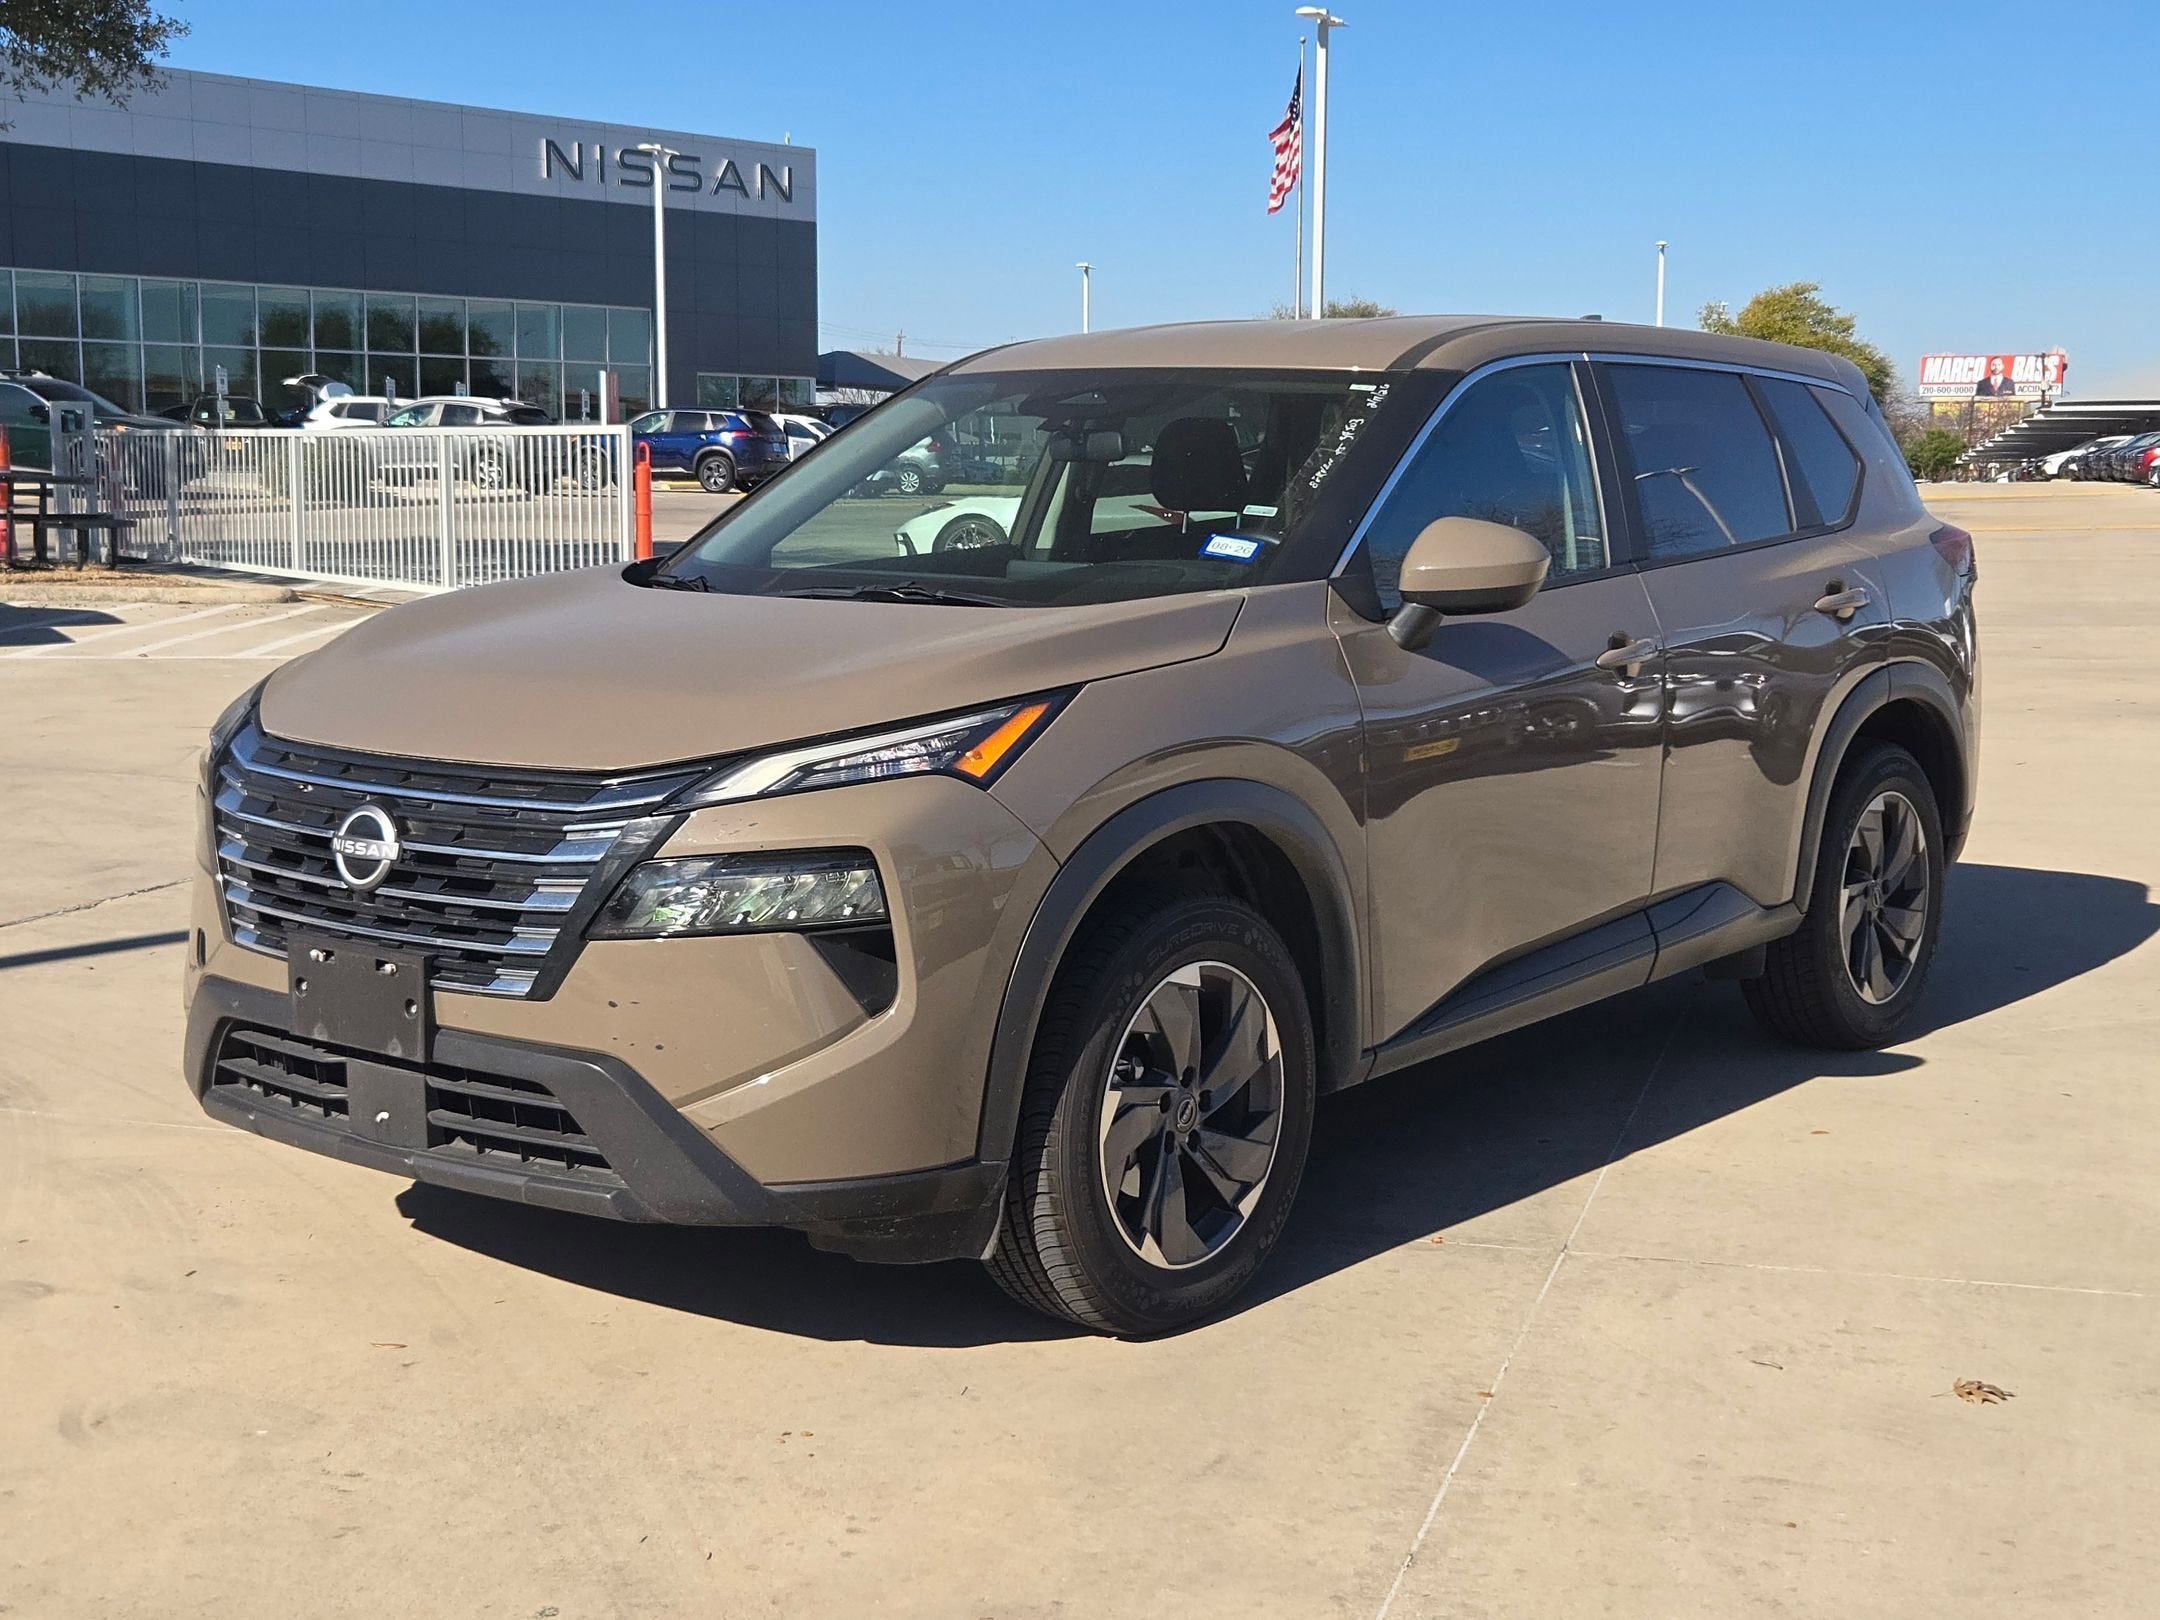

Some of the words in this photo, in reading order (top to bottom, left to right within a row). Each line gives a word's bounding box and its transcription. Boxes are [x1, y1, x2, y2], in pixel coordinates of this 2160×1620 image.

[541, 138, 793, 202] NISSAN
[1923, 357, 1987, 383] MARCO
[2011, 356, 2060, 382] BASS
[1922, 386, 1974, 394] 210-600-0000
[2017, 385, 2059, 393] ACCIDT?
[333, 837, 396, 859] NISSAN
